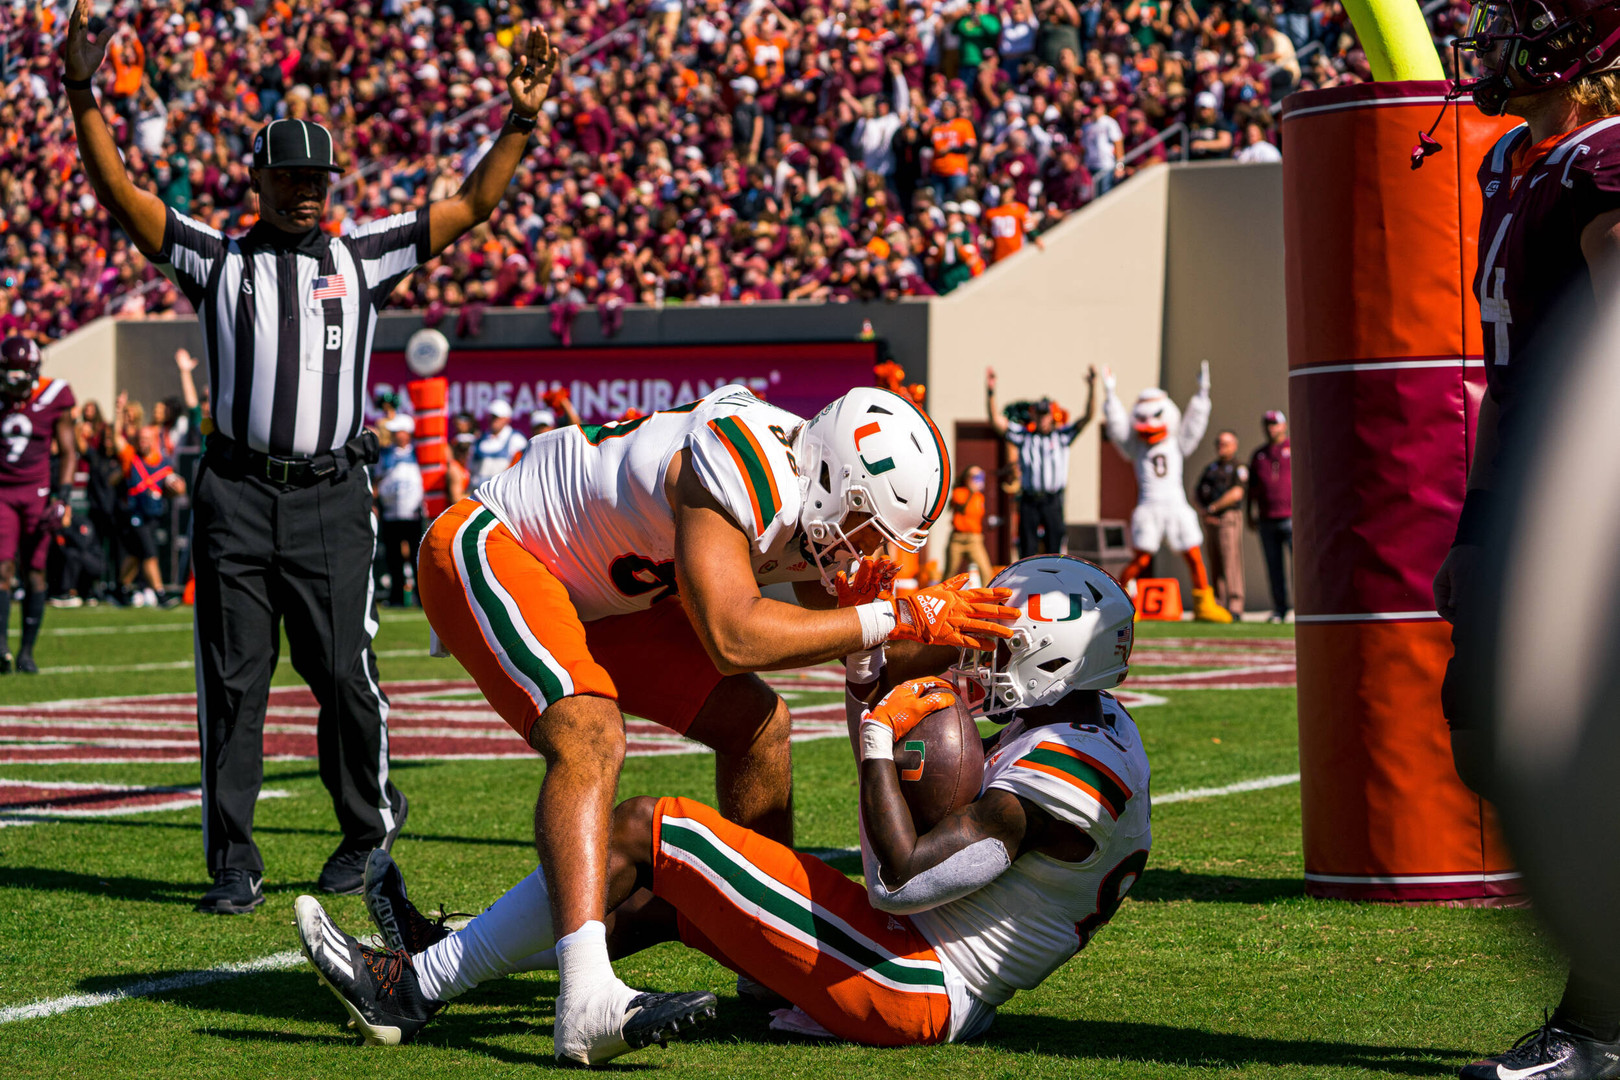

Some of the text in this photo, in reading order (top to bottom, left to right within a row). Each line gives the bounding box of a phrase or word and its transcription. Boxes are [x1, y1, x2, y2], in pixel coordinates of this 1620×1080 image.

[1481, 213, 1513, 366] 4
[325, 325, 342, 350] B
[448, 379, 561, 421] UREA
[569, 377, 768, 420] INSURAN
[1, 413, 33, 463] 9
[853, 421, 896, 476] U
[916, 595, 937, 625] adidas
[1027, 593, 1083, 622] U
[1143, 585, 1164, 614] G
[901, 740, 926, 781] U
[371, 894, 406, 954] ADIZE
